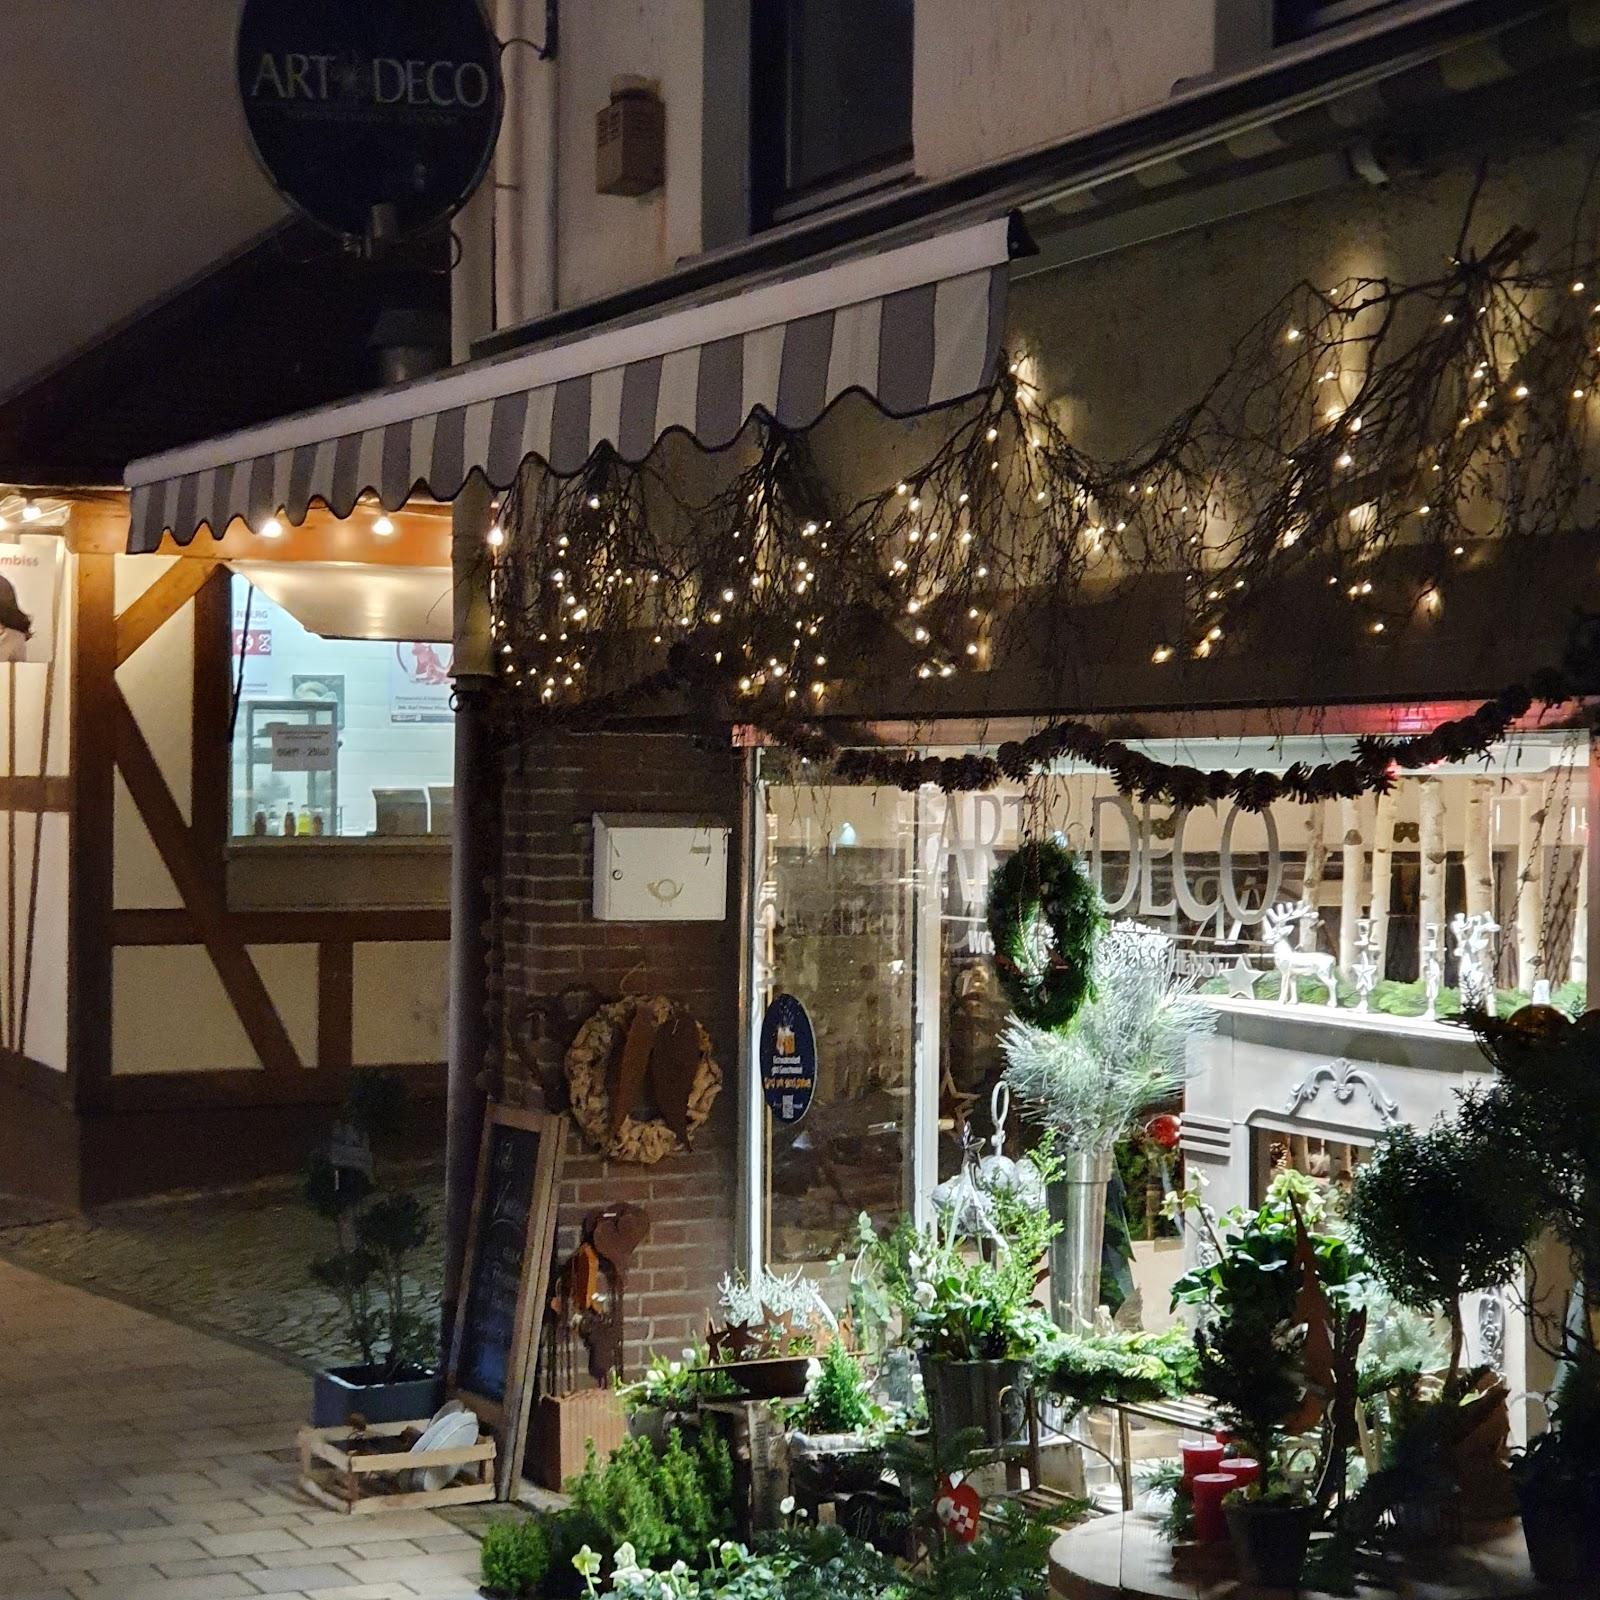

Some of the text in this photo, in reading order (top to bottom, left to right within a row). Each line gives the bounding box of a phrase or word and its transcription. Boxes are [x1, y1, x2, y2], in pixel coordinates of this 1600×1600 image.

[251, 53, 488, 107] ART DECO
[1091, 795, 1280, 925] DECO
